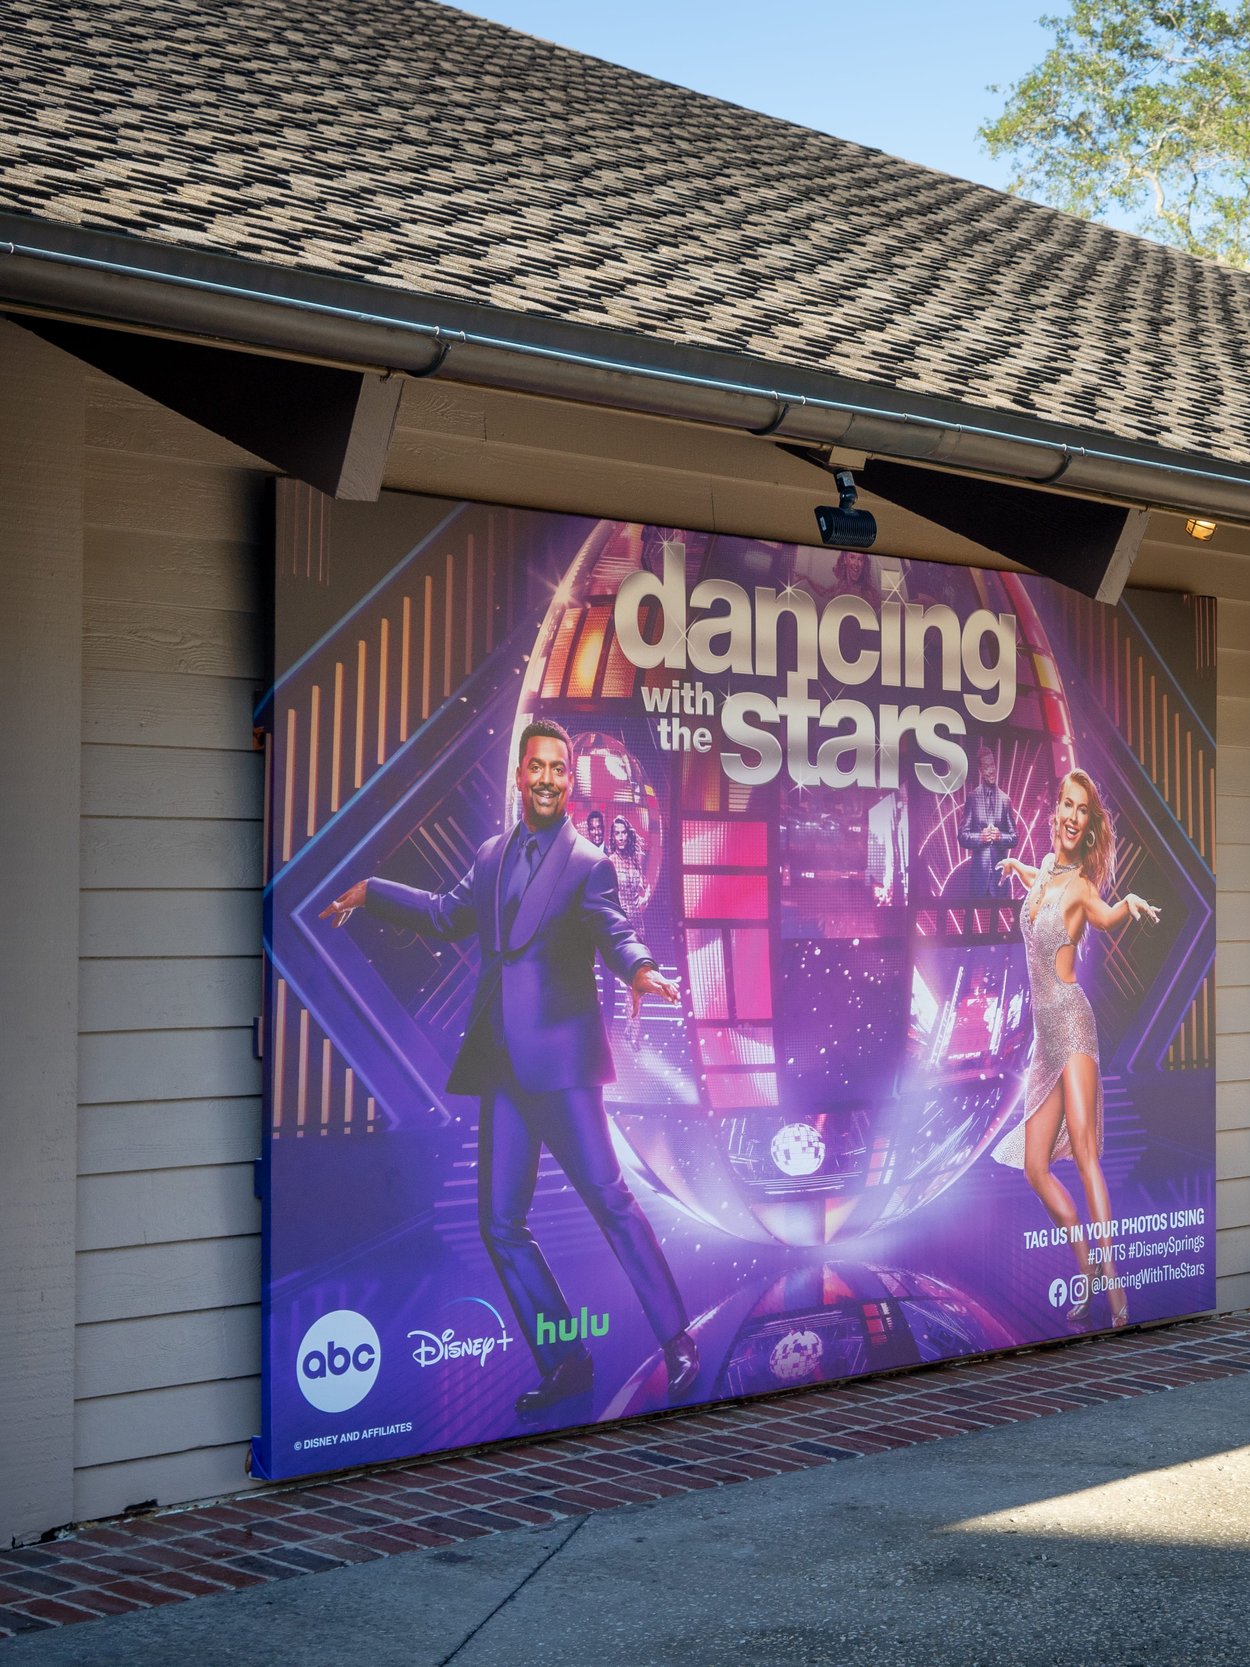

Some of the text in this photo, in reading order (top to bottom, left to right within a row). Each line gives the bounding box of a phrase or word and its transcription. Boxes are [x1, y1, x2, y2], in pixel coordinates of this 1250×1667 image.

[614, 541, 1017, 723] dancing
[641, 682, 714, 716] with
[657, 717, 713, 753] the
[720, 671, 968, 794] stars
[1024, 1207, 1205, 1249] TAG US IN YOUR PHOTOS USING
[1087, 1234, 1205, 1265] #DWTS #DisneySprings
[1091, 1262, 1205, 1294] @DancingWithTheStars
[536, 1307, 610, 1345] hulu
[302, 1341, 376, 1379] abc
[406, 1328, 514, 1368] Disney+
[303, 1434, 339, 1450] DISNEY
[340, 1431, 361, 1443] AND
[361, 1422, 413, 1440] AFFILIATES
